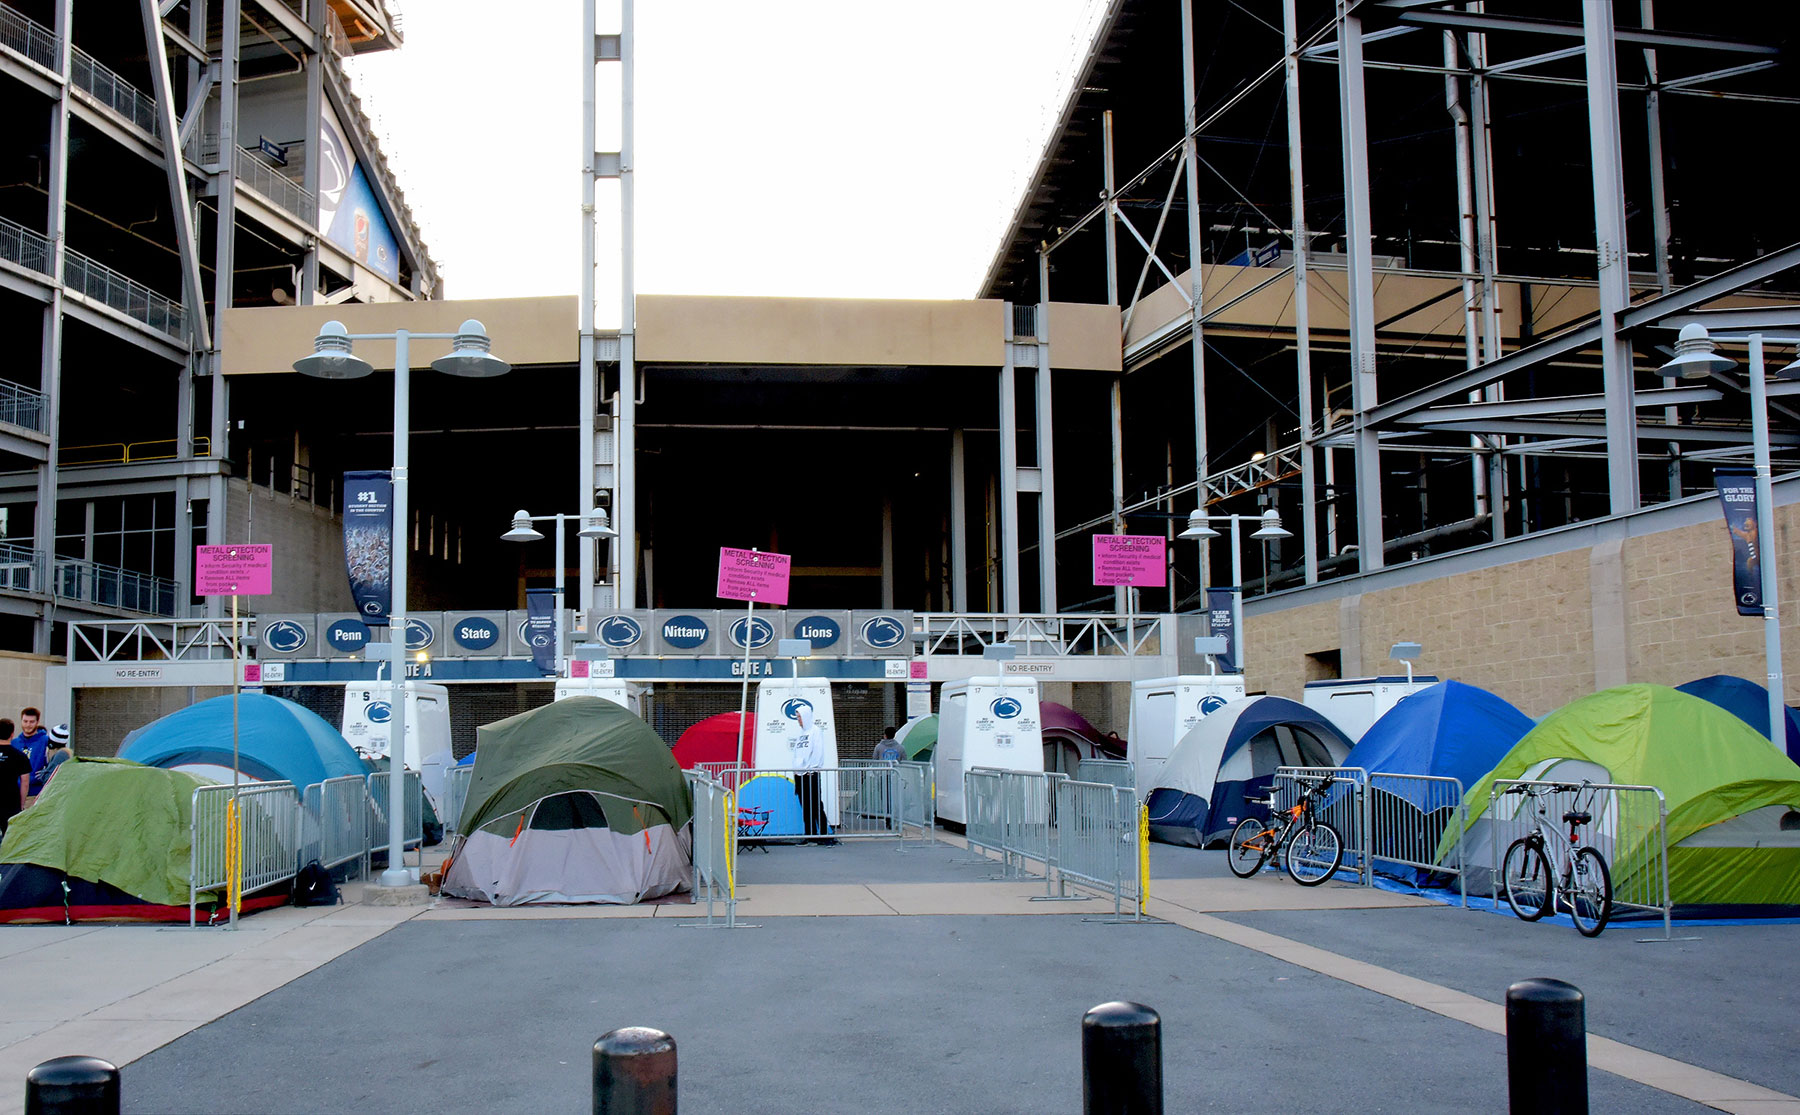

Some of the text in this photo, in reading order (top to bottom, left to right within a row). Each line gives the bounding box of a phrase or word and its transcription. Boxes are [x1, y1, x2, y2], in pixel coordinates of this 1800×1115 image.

[357, 492, 378, 503] #1
[725, 550, 787, 563] METAL DETECTION
[736, 559, 775, 569] SCREENING
[335, 629, 362, 640] Penn
[461, 627, 490, 639] State
[664, 626, 706, 640] Nittany
[802, 626, 832, 638] Lions
[405, 664, 432, 677] TE A
[732, 662, 773, 675] GATE A
[363, 692, 370, 701] S
